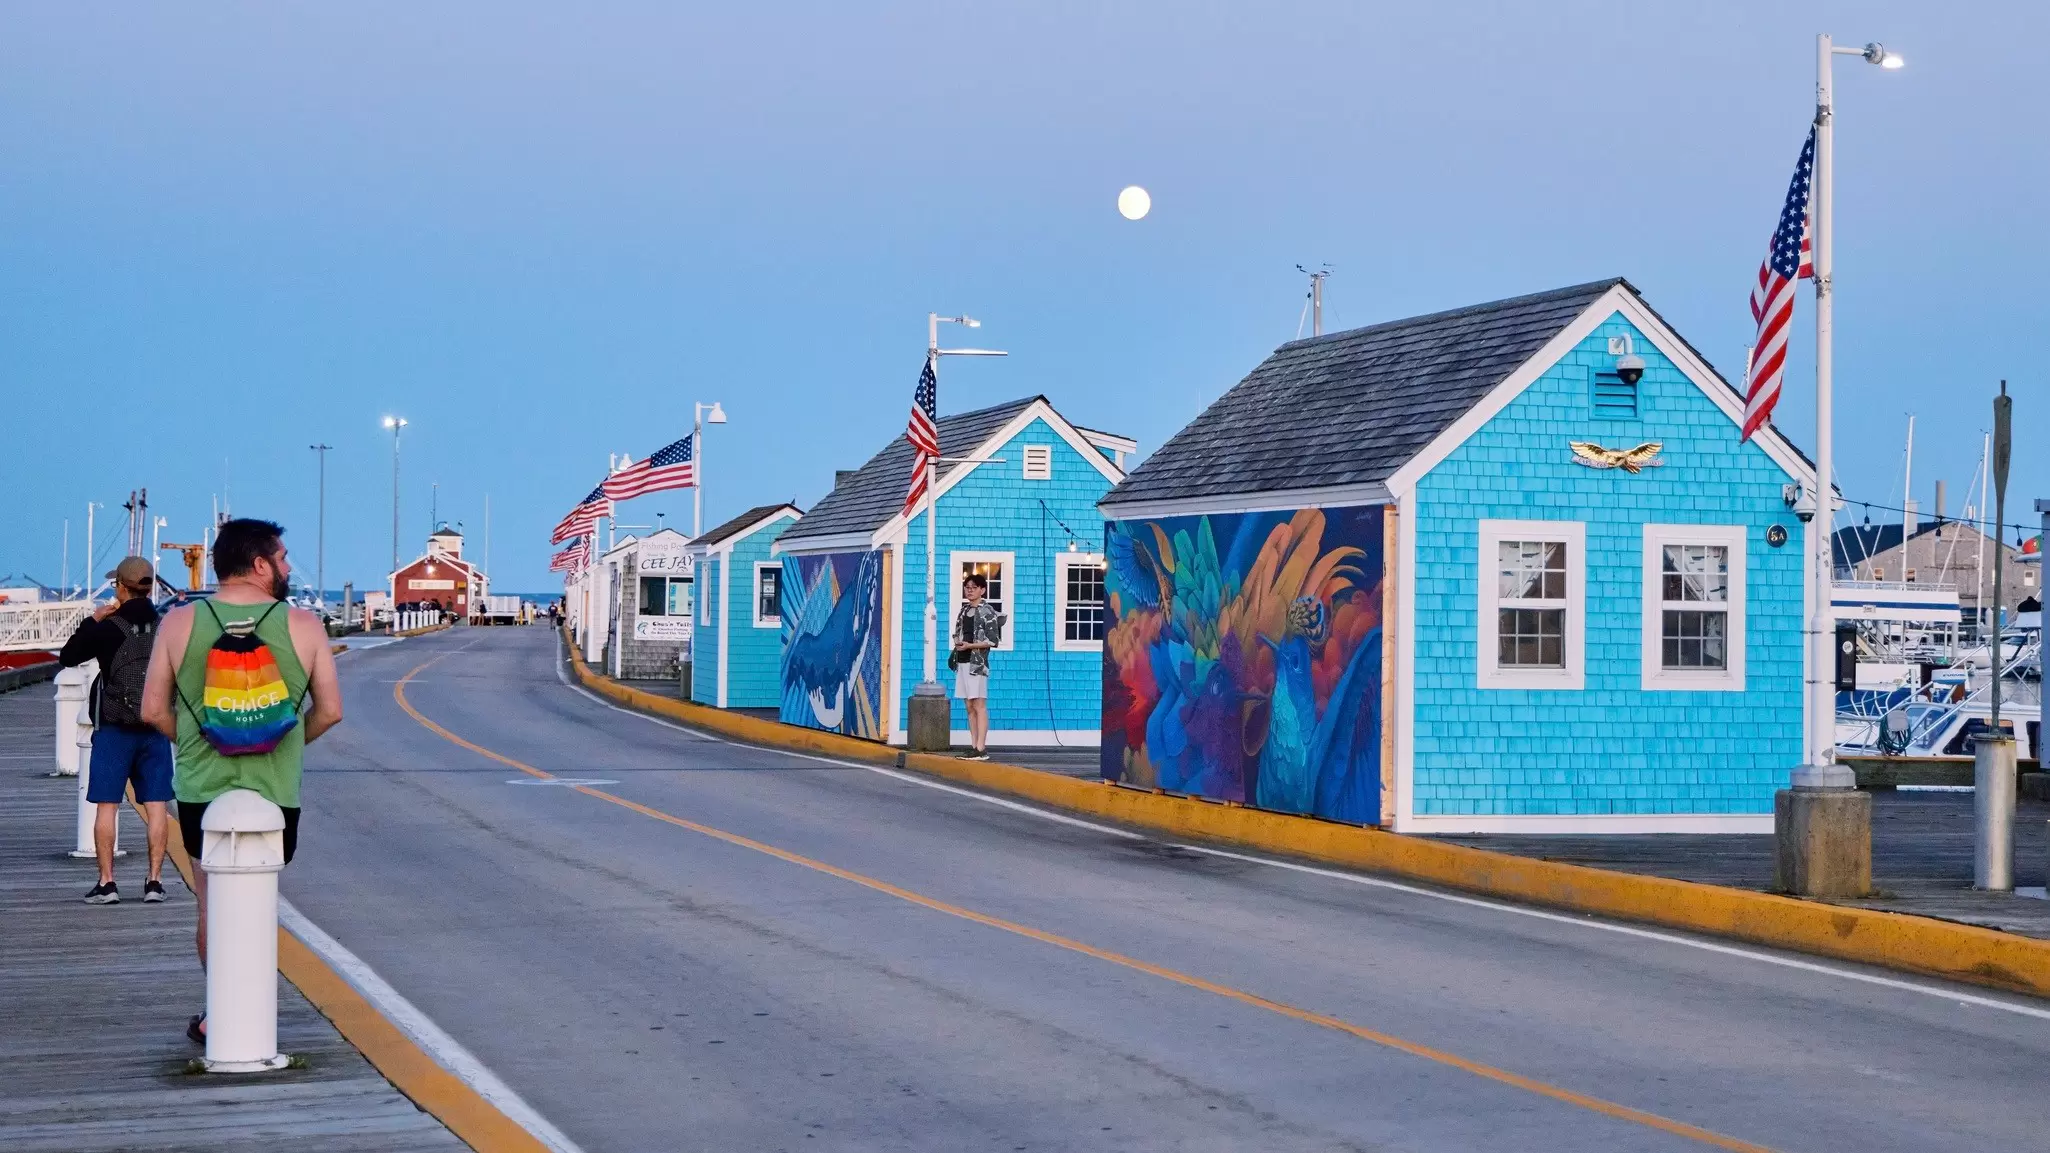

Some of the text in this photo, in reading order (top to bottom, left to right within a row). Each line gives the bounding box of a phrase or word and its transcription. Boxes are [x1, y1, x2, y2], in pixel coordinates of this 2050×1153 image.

[1770, 530, 1785, 541] 5A
[641, 542, 669, 551] Fishing
[641, 557, 667, 570] CEE
